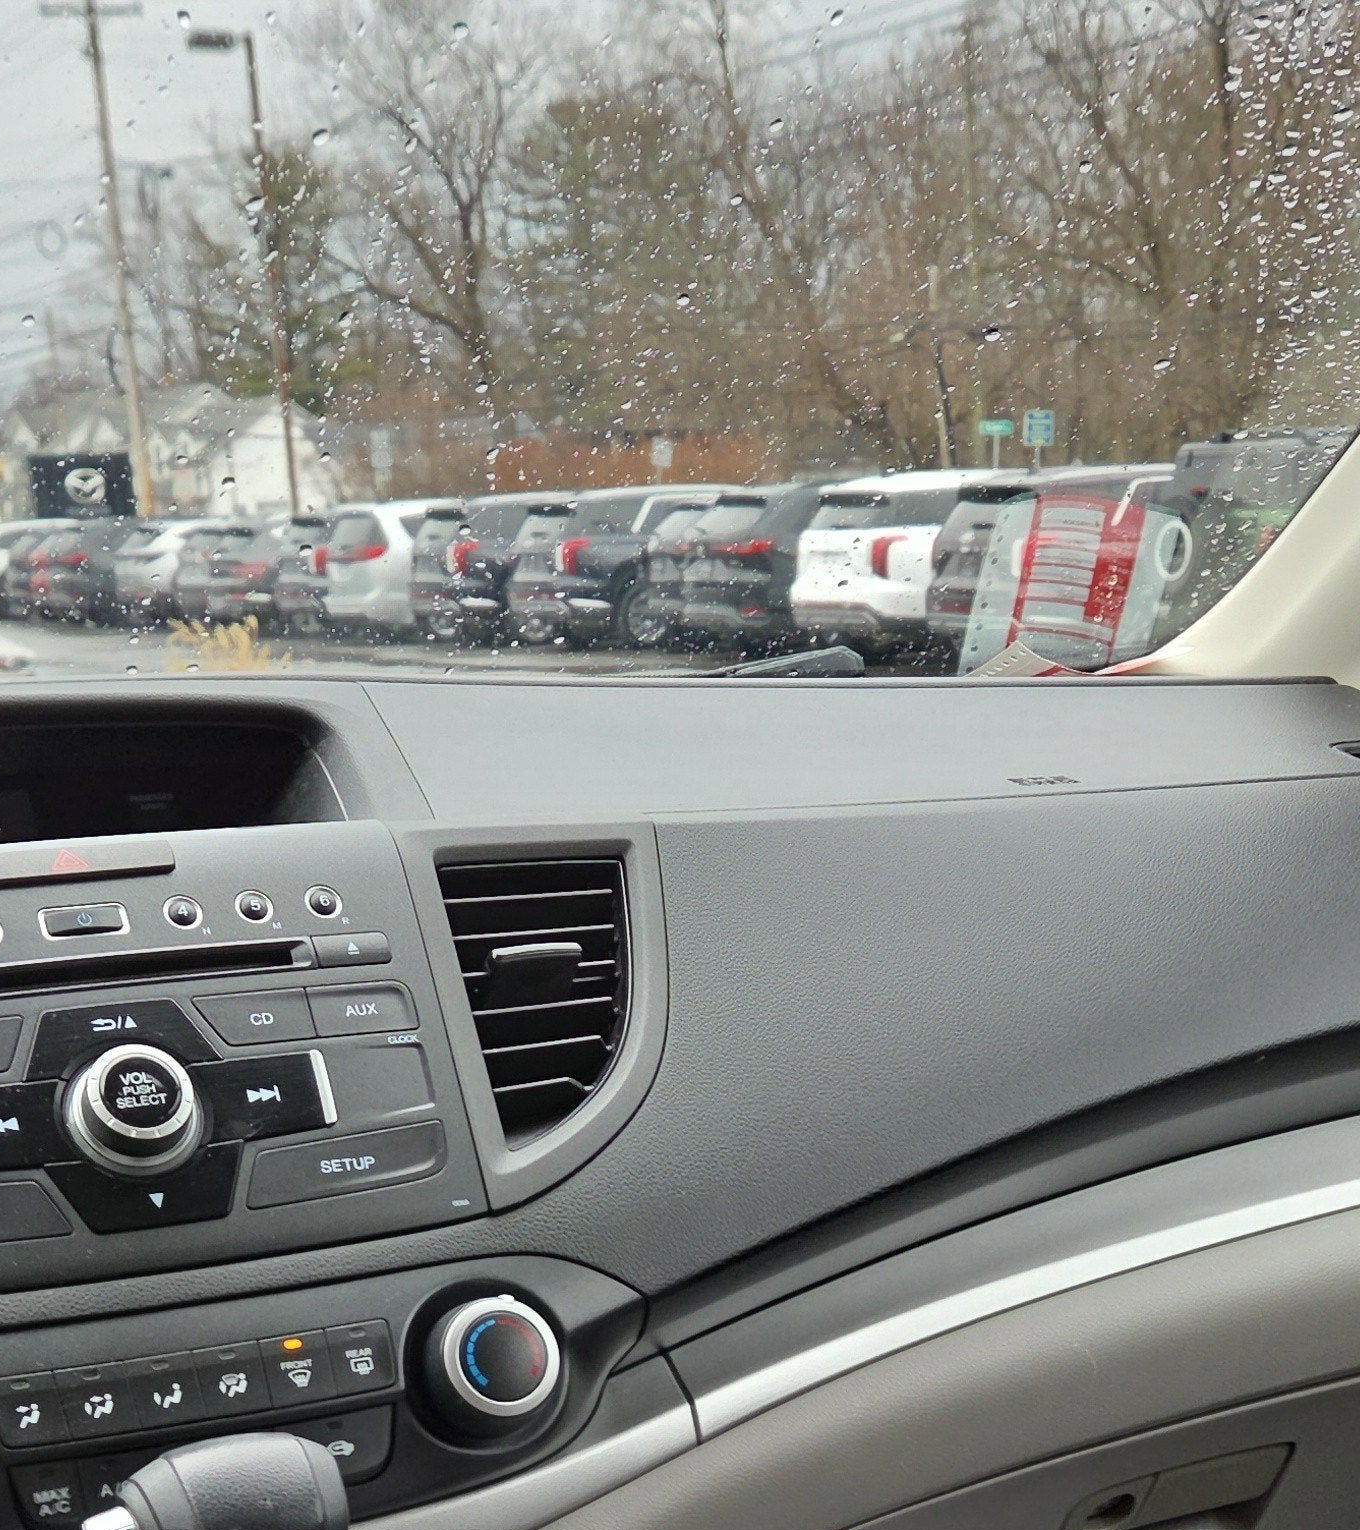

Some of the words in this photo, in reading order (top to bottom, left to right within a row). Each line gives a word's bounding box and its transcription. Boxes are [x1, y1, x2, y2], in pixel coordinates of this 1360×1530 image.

[250, 900, 261, 911] 5
[319, 895, 330, 907] 6
[177, 905, 189, 917] 4
[345, 1002, 379, 1017] AUX
[249, 1012, 274, 1026] CD
[387, 1034, 419, 1045] CLOCK
[119, 1071, 153, 1086] VOL
[122, 1083, 157, 1096] PUSH
[115, 1092, 168, 1110] SELECT
[320, 1155, 376, 1174] SETUP
[344, 1347, 373, 1359] REAR
[279, 1358, 313, 1371] FRONT
[32, 1486, 72, 1505] MAX
[38, 1500, 72, 1518] A/C
